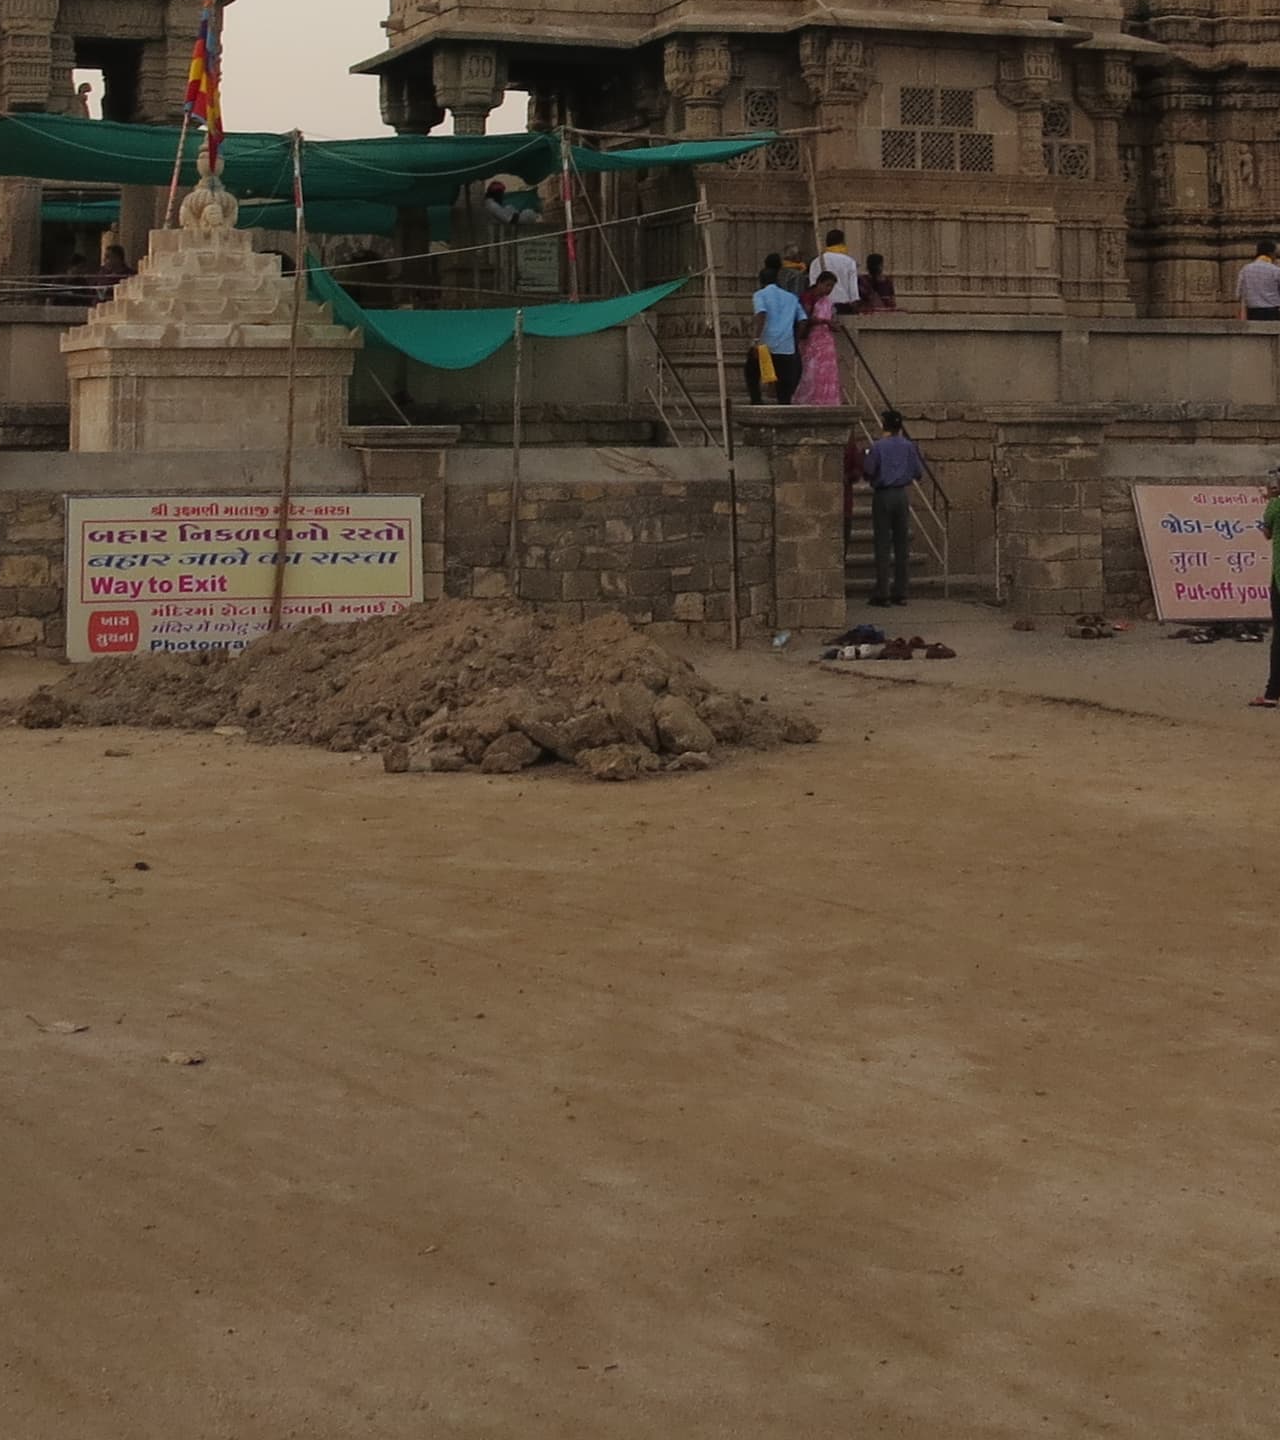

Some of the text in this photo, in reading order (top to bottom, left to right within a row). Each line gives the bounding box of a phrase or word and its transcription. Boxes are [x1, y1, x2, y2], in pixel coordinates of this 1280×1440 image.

[88, 528, 168, 544] બહાર
[91, 574, 227, 598] Way to Exit
[1175, 581, 1233, 600] Put-off
[150, 639, 249, 651] Photogra
